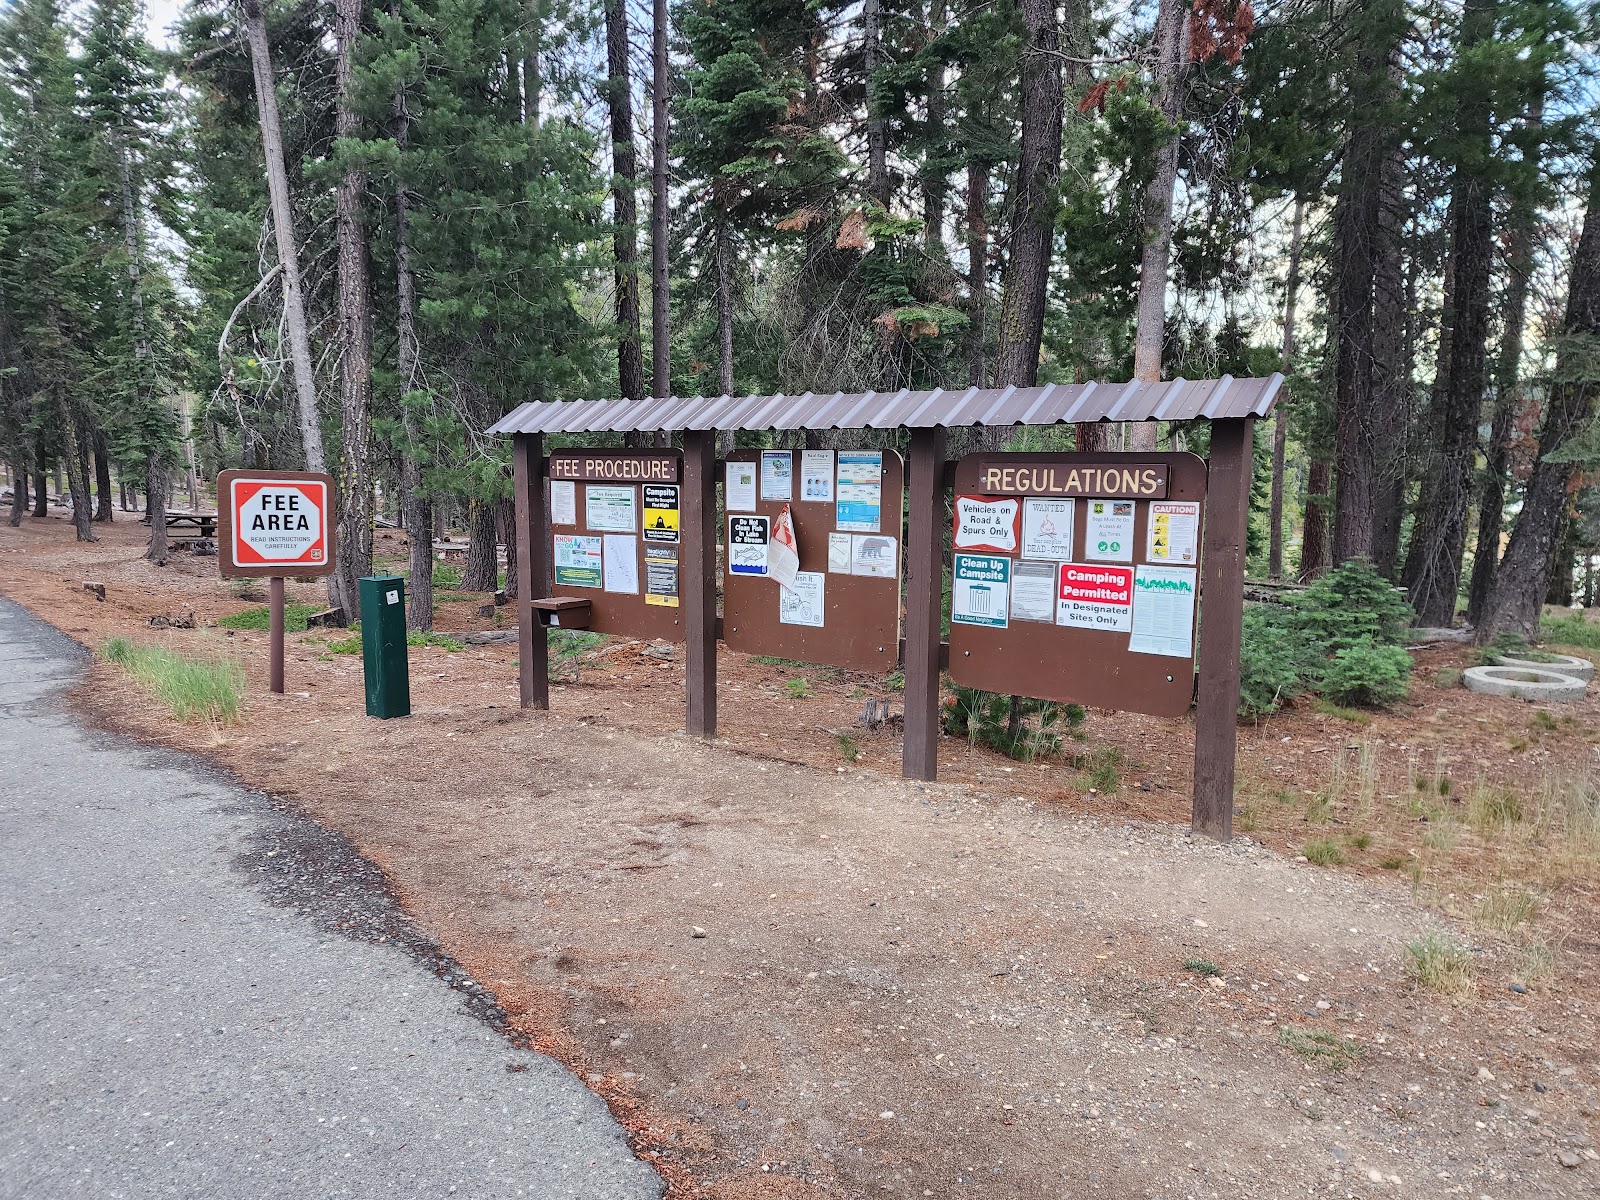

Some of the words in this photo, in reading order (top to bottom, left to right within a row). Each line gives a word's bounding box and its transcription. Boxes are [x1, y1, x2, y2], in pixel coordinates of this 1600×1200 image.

[556, 460, 580, 476] FEE
[586, 460, 670, 478] PROCEDURE
[986, 468, 1157, 494] REGULATIONS
[646, 488, 675, 497] Campsite
[262, 495, 299, 510] FEE
[1032, 503, 1065, 512] WANTED
[963, 504, 996, 514] Vehicles
[1154, 506, 1195, 514] CAUTION!
[252, 515, 309, 530] AREA
[970, 516, 992, 525] Road
[962, 526, 985, 536] Spurs
[989, 527, 1009, 537] Only
[961, 558, 988, 568] Clean
[990, 560, 1004, 571] Up
[960, 568, 1004, 580] Campsite
[1067, 570, 1125, 587] Camping
[1063, 586, 1128, 601] Permitted
[1073, 603, 1128, 615] Designated
[1069, 613, 1093, 622] Sites
[1096, 615, 1118, 626] Only
